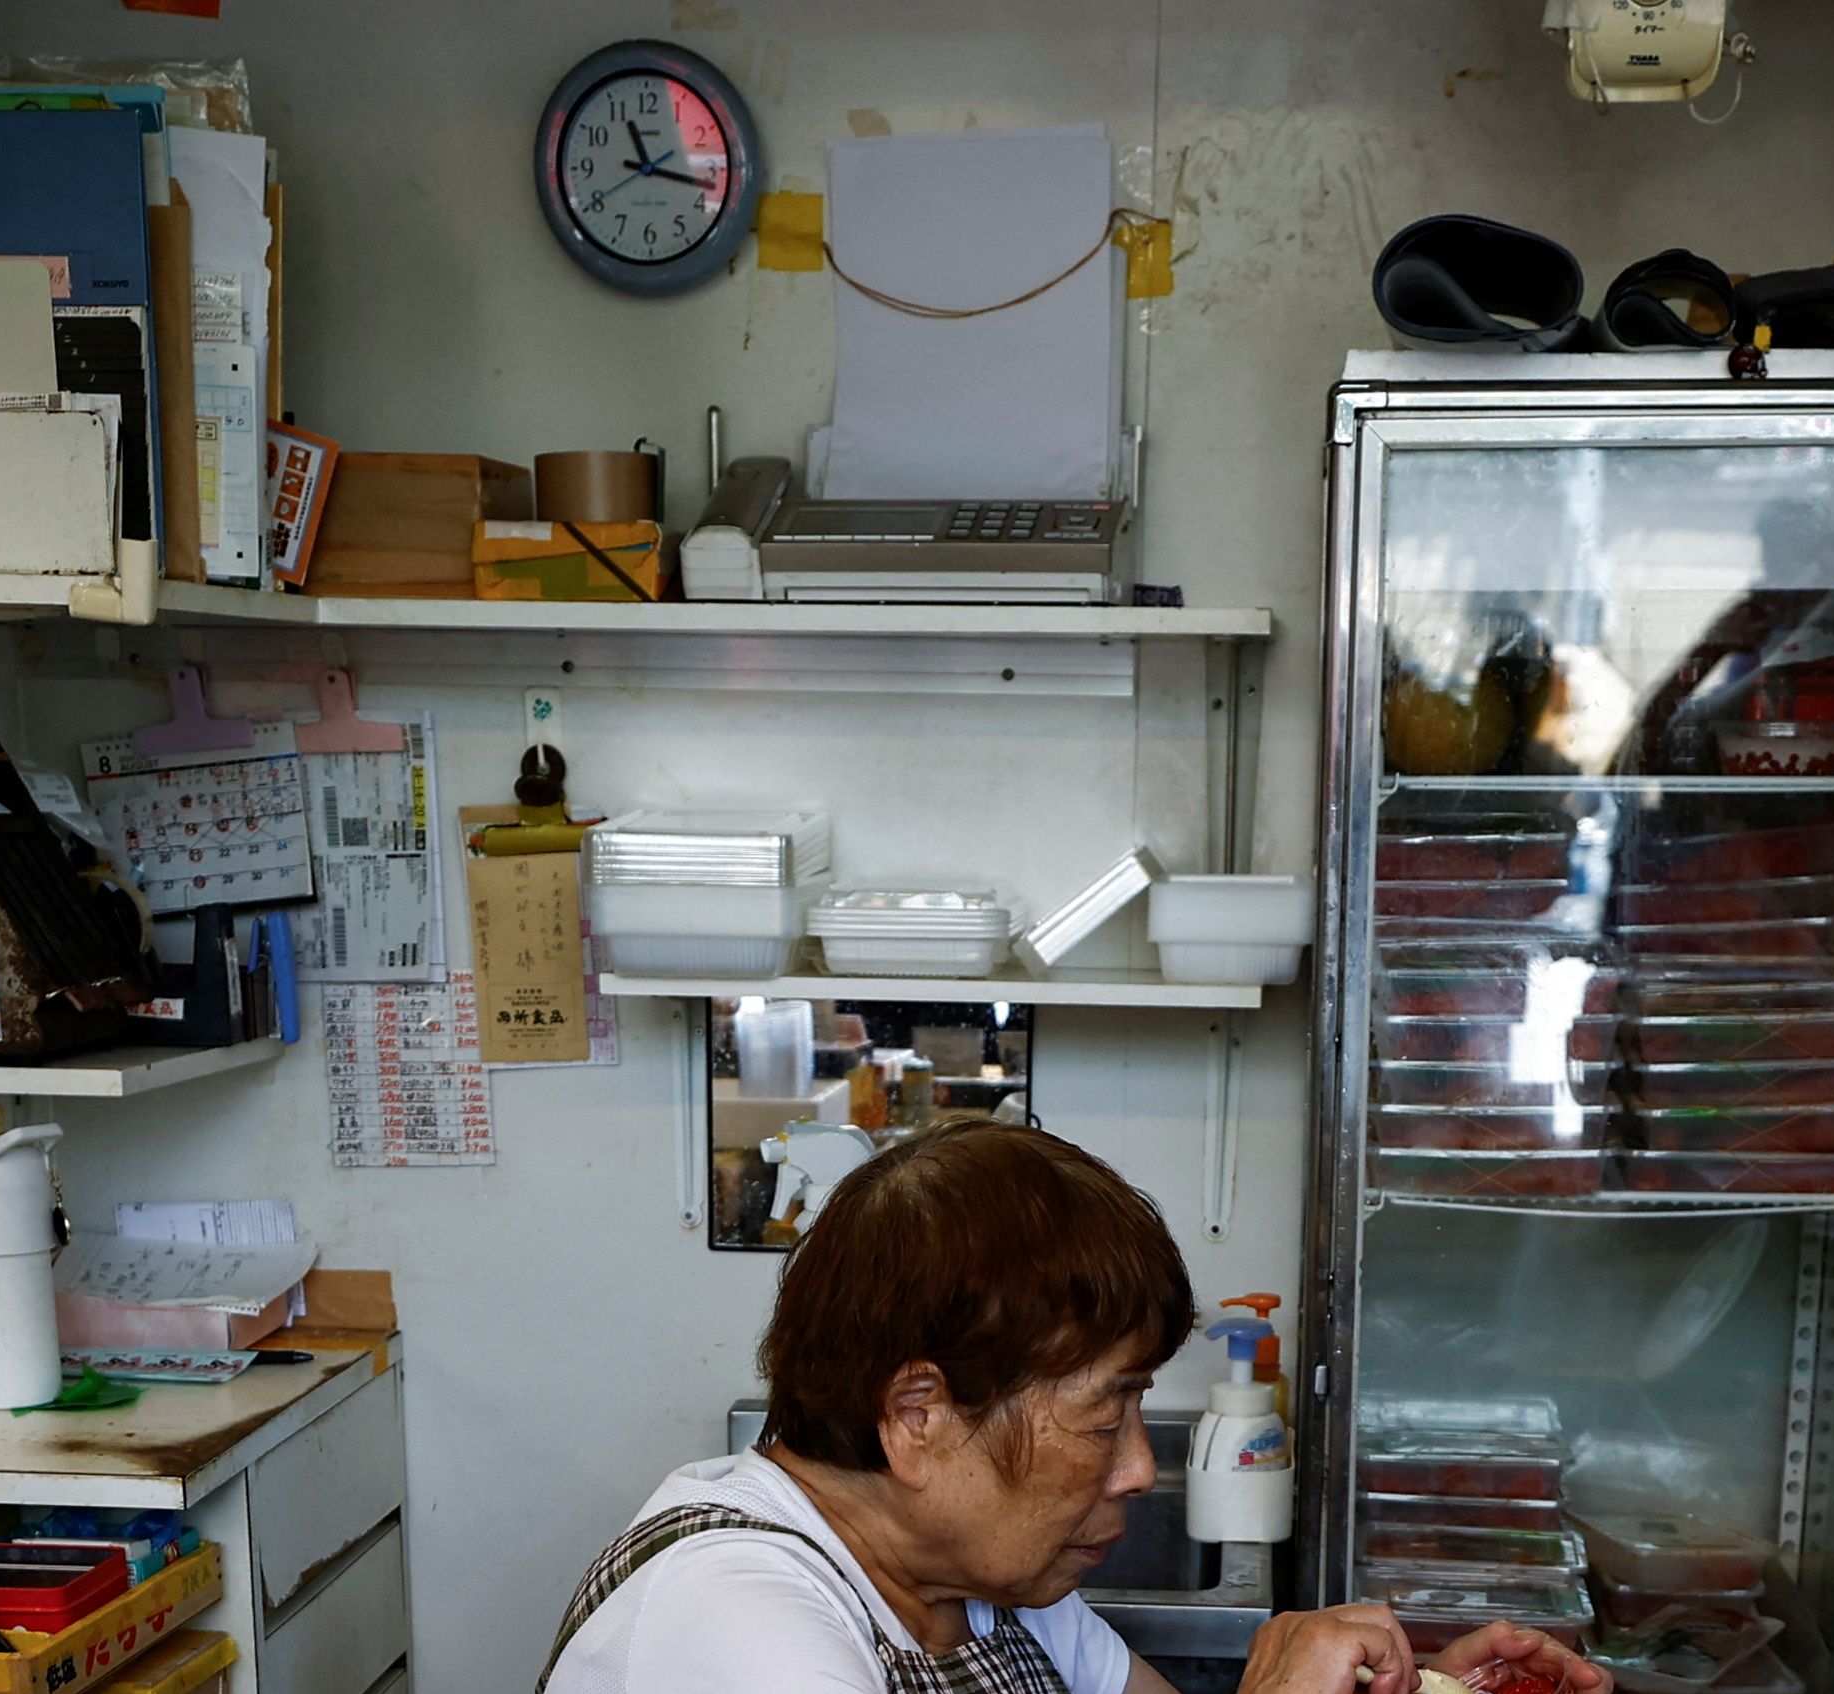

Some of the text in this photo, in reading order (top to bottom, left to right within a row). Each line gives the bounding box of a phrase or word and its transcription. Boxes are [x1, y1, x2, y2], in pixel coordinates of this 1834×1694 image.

[1634, 25, 1665, 34] タイマー
[610, 101, 626, 122] 11
[638, 92, 659, 114] 12
[674, 101, 680, 124] 1
[587, 125, 609, 147] 10
[694, 125, 706, 147] 2
[580, 157, 594, 179] 9
[591, 190, 605, 213] 8
[694, 192, 705, 213] 4
[614, 214, 627, 236] 7
[642, 222, 657, 245] 6
[673, 215, 686, 237] 5
[98, 756, 112, 774] 8
[496, 1009, 566, 1025] 田所食品
